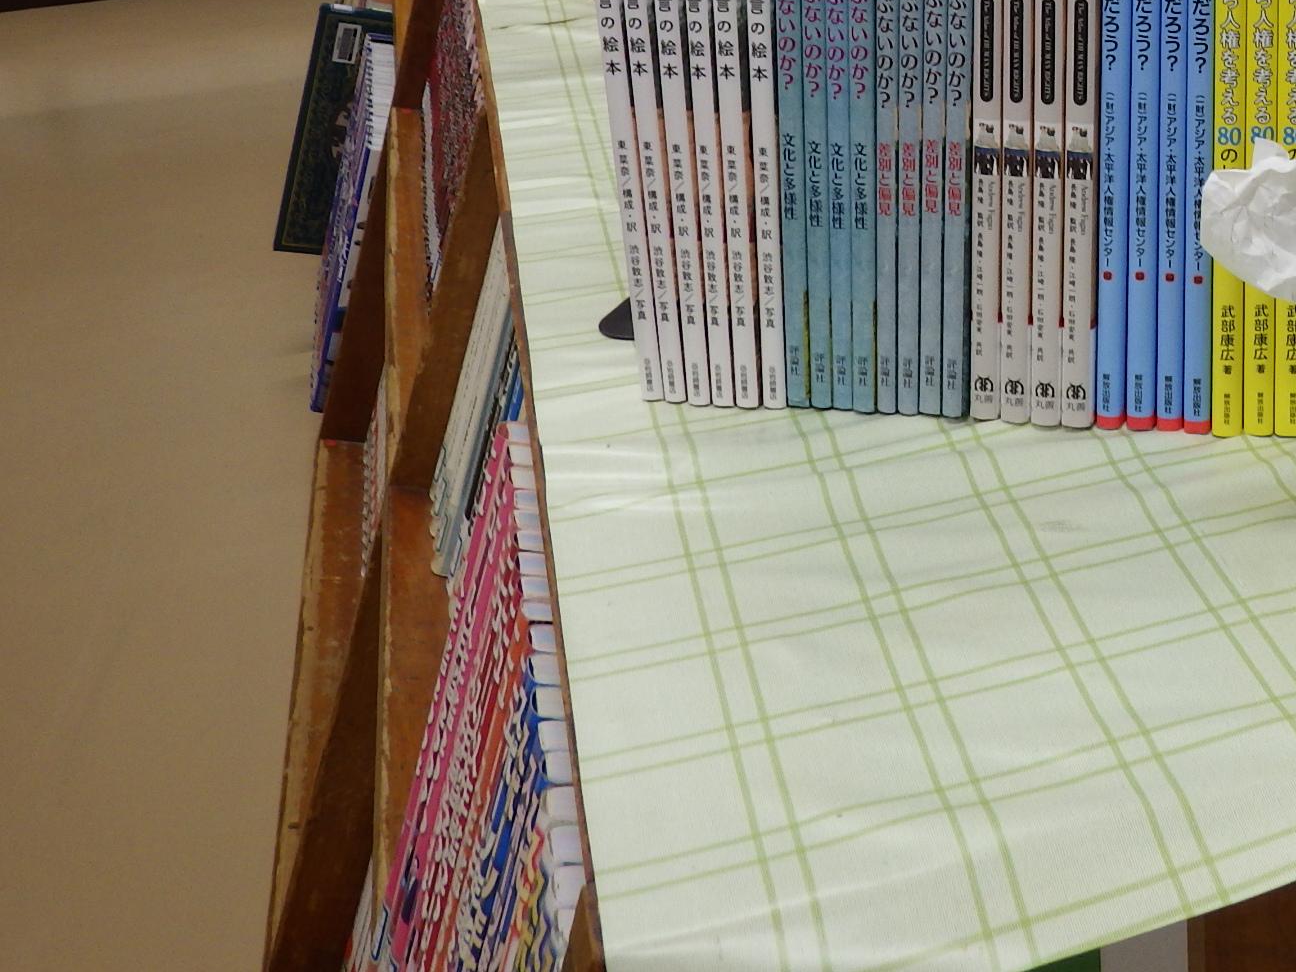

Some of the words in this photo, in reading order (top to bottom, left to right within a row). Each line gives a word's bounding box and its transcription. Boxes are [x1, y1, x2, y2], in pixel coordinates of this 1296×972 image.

[782, 133, 797, 220] 文化と多様性
[808, 140, 822, 227] 文化と多様性
[830, 142, 845, 229] 文化と多様性
[854, 142, 868, 229] 文化と多様性
